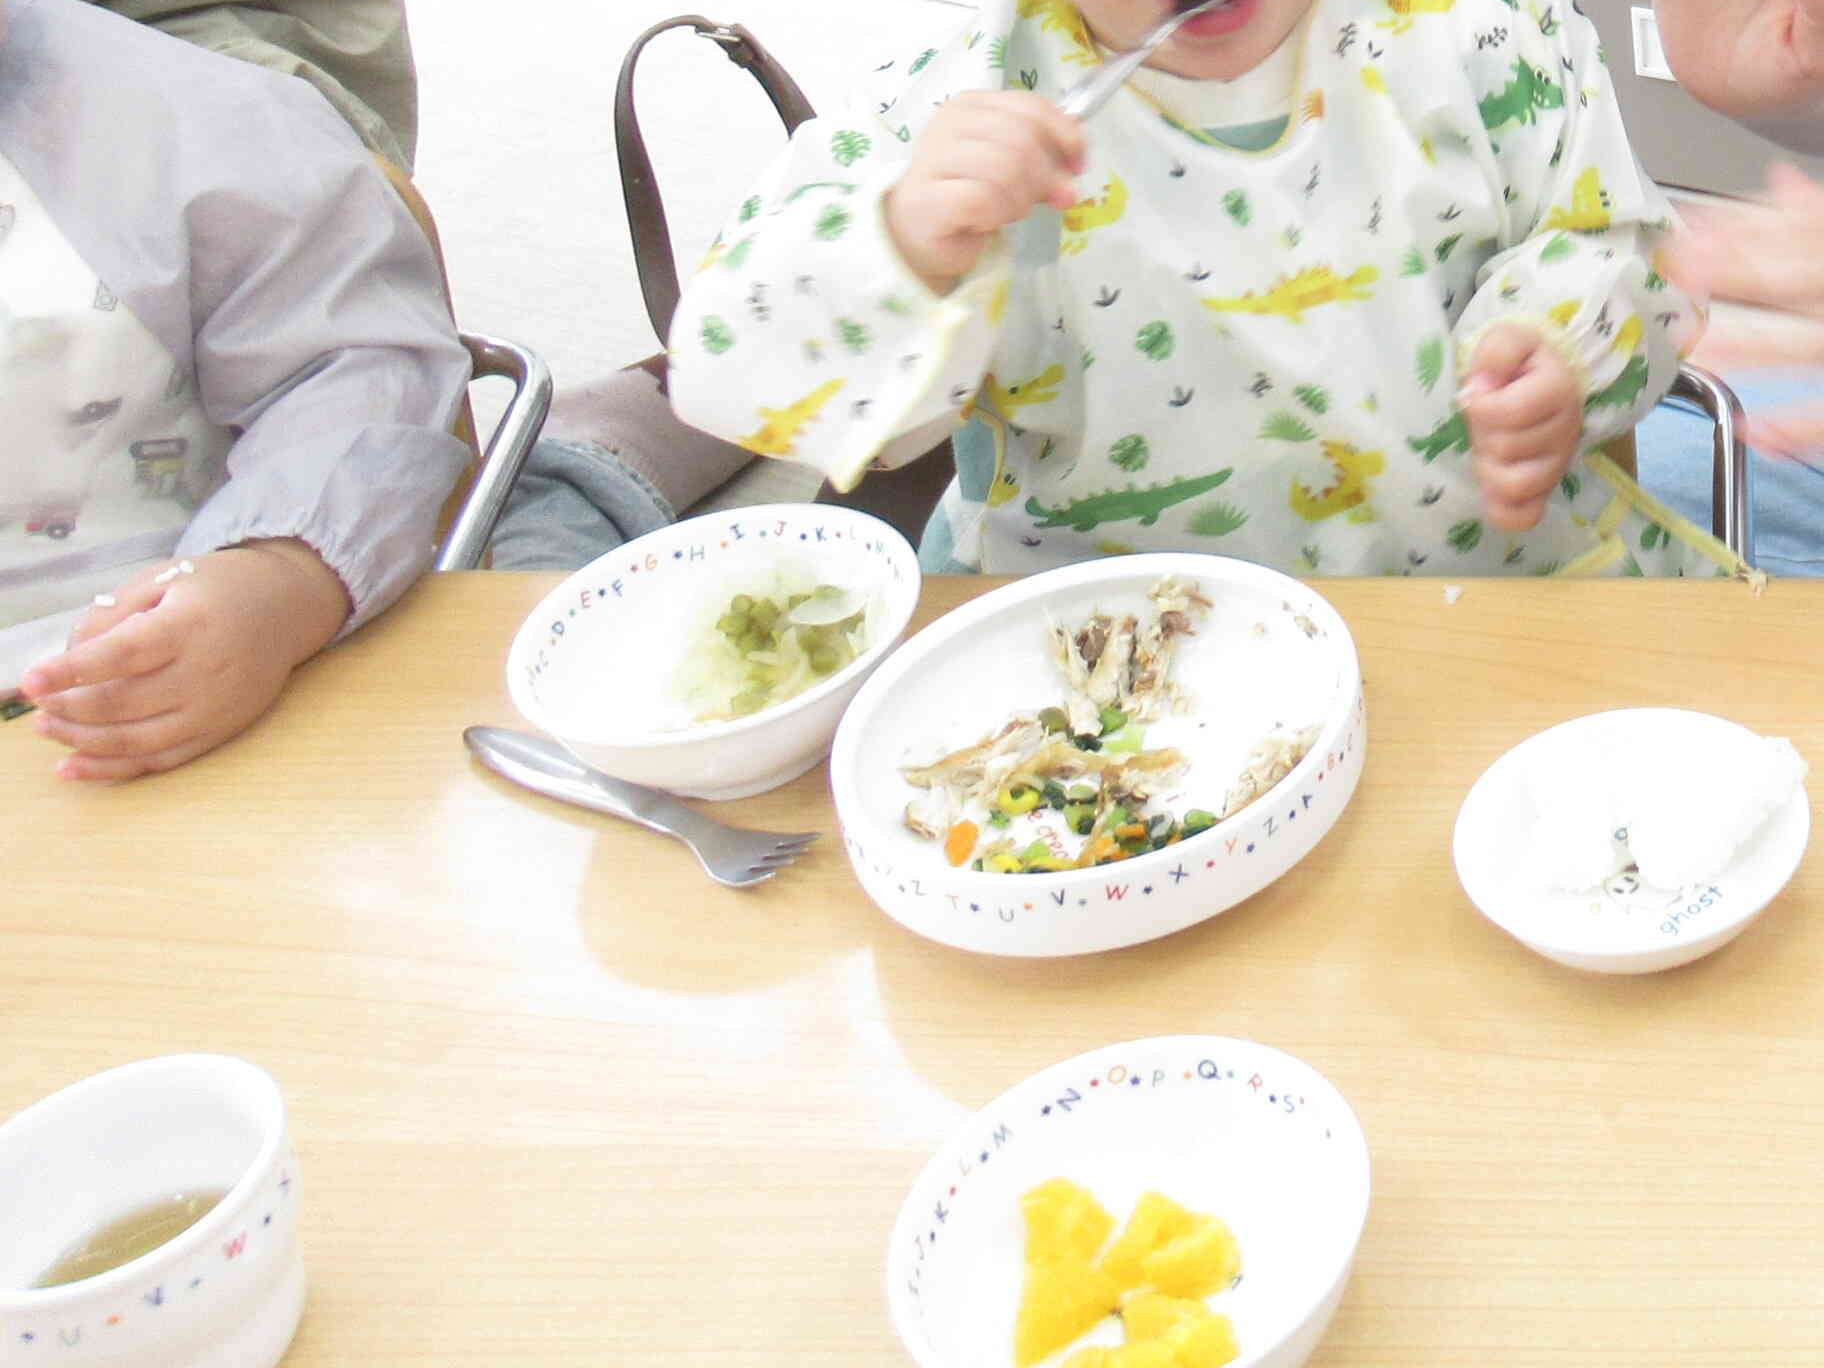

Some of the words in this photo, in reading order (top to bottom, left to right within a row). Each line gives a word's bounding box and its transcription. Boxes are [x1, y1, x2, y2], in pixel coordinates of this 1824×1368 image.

[580, 590, 593, 609] E
[611, 578, 625, 599] F
[645, 553, 658, 572] G
[689, 544, 706, 561] H
[774, 520, 789, 536] J
[998, 905, 1015, 923] U
[1049, 888, 1066, 907] V
[1104, 884, 1130, 901] W
[1167, 862, 1190, 885] X
[1224, 832, 1239, 856] Y
[1659, 885, 1724, 937] ghost
[1056, 1087, 1083, 1113] N
[1107, 1063, 1128, 1085] O
[1151, 1069, 1166, 1088] P
[1197, 1059, 1222, 1080] Q
[1247, 1072, 1264, 1094] R
[1282, 1093, 1295, 1113] S
